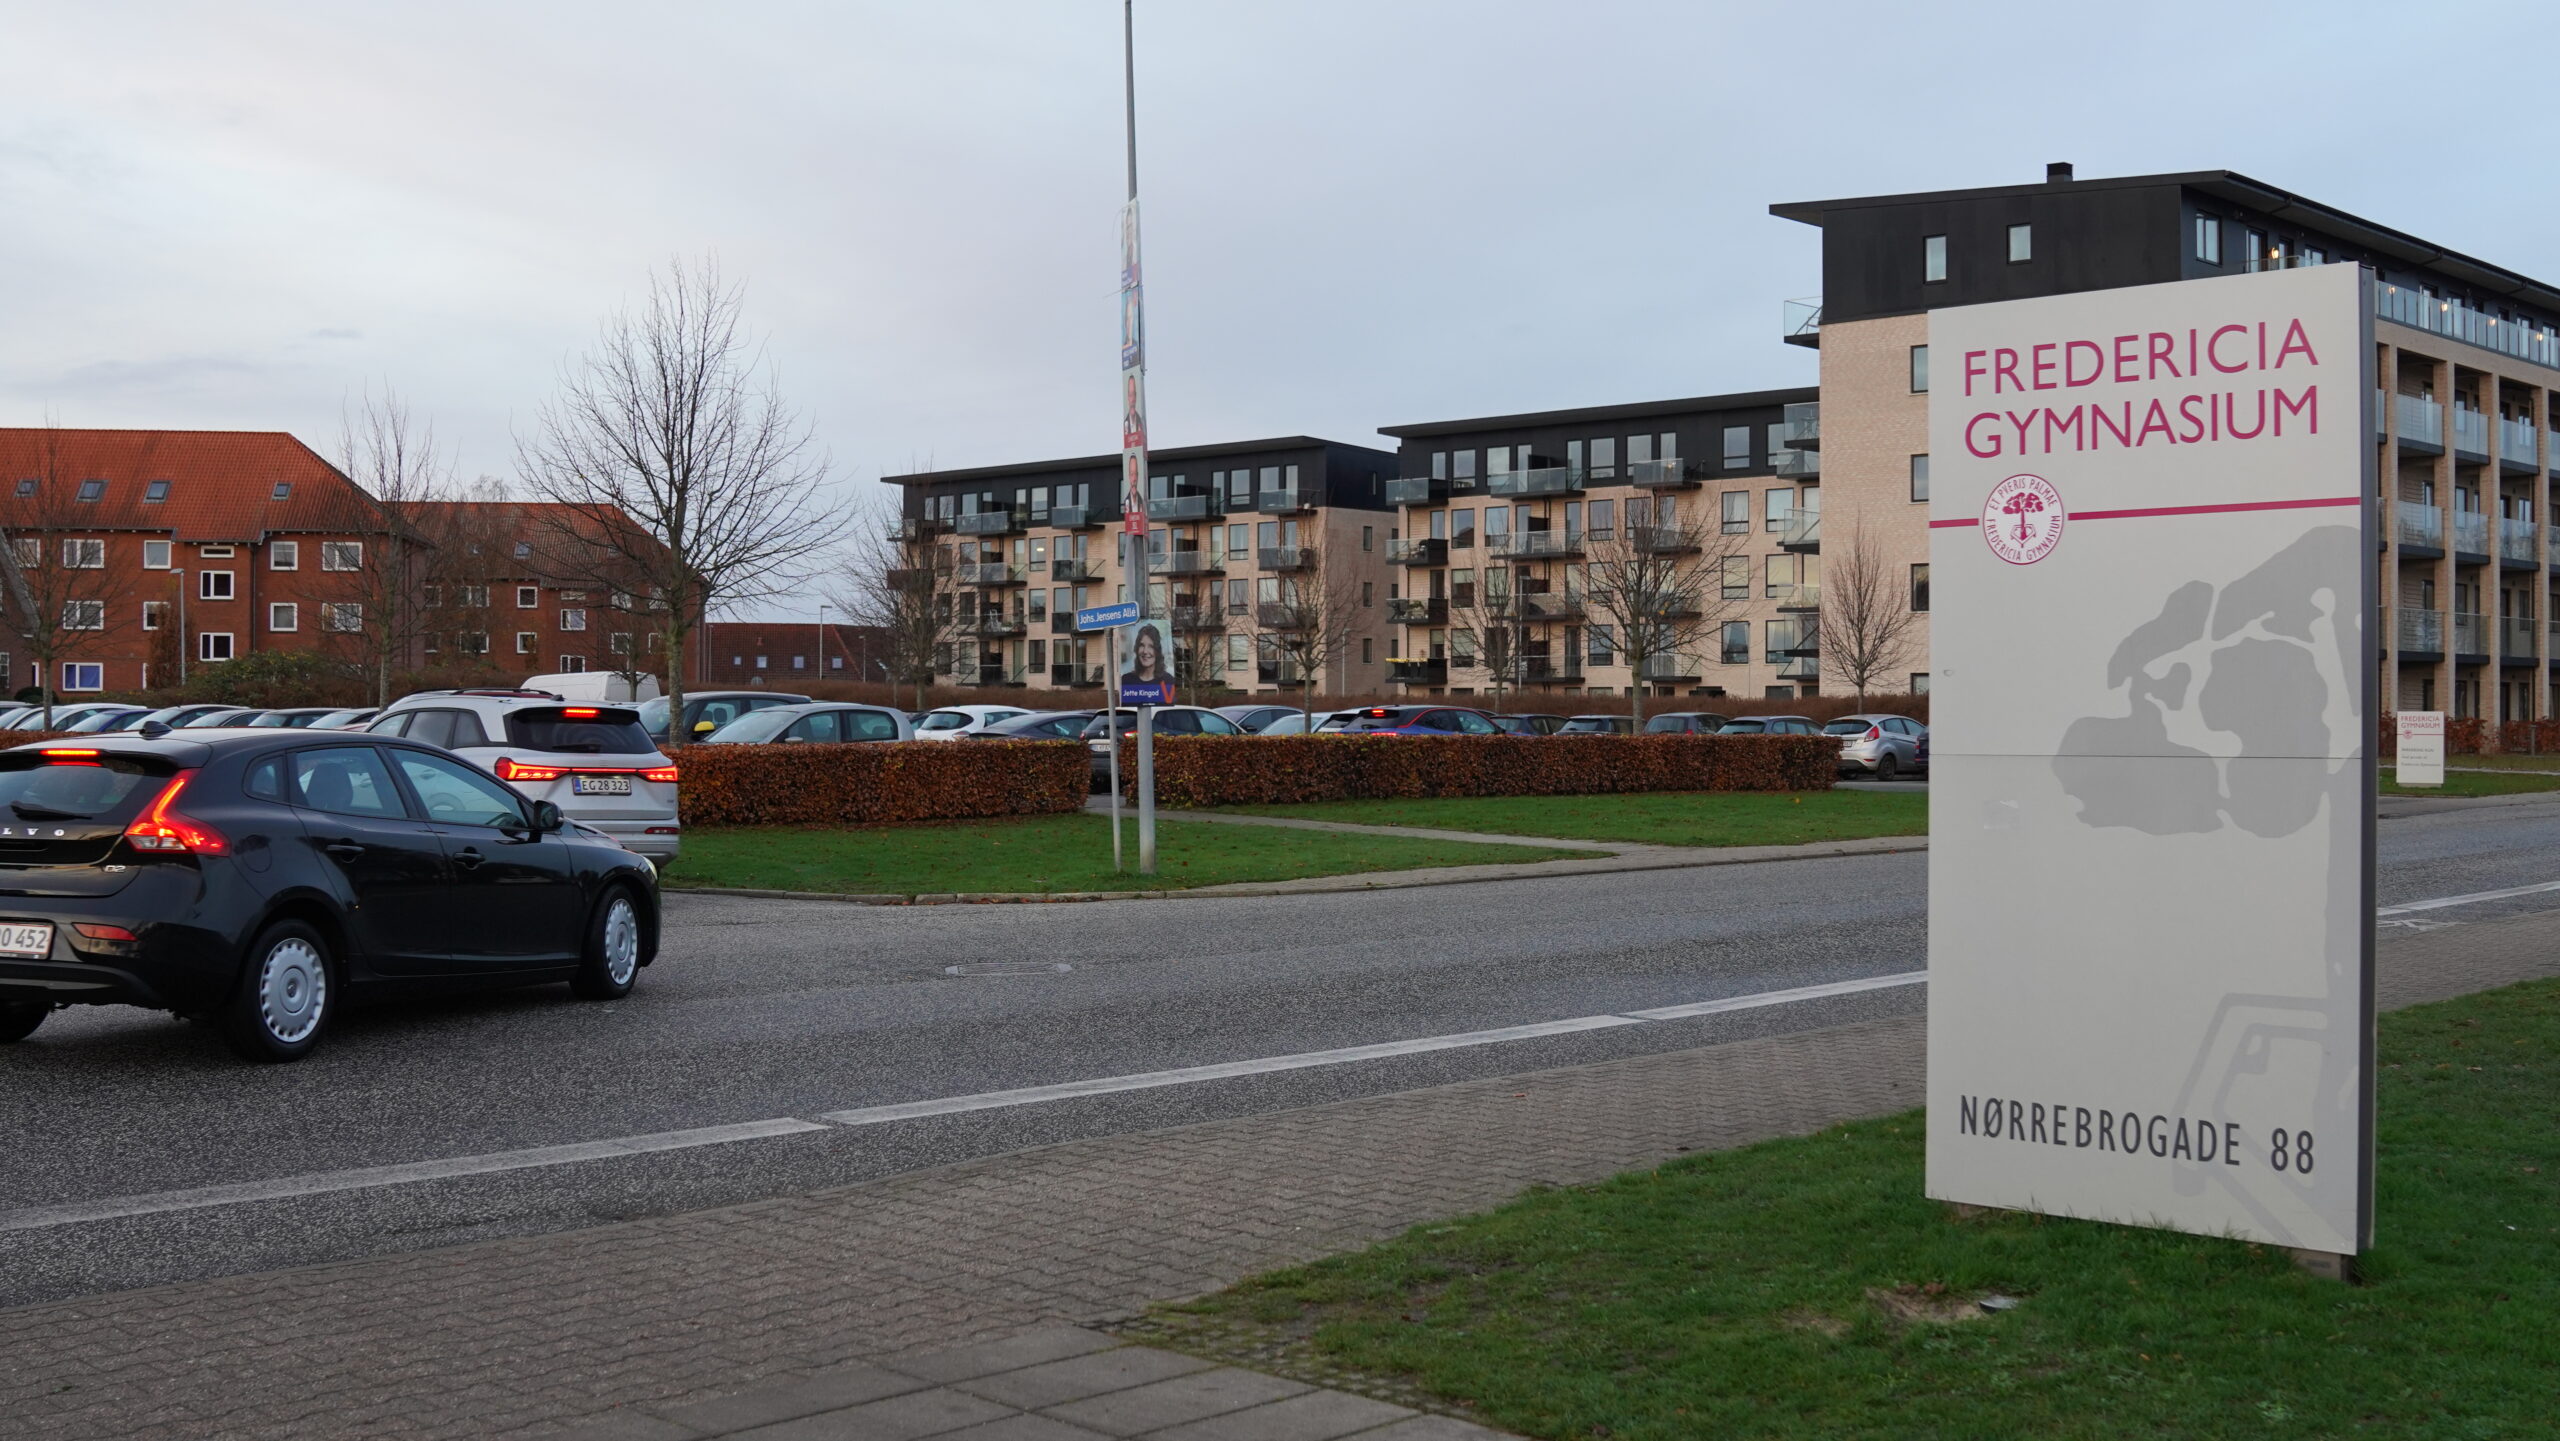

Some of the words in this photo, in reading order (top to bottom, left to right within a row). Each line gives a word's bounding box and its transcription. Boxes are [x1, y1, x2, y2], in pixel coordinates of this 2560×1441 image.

[1964, 318, 2319, 397] FREDERICIA
[1964, 385, 2318, 459] GYMNASIUM
[1986, 519, 2021, 561] FREDERICIA
[2026, 515, 2061, 560] GYMNASIUM
[1097, 611, 1122, 621] Jensens
[1122, 607, 1136, 618] Allé
[1139, 689, 1159, 698] Kingod
[582, 780, 596, 791] EG
[598, 780, 609, 791] 28
[611, 780, 629, 791] 323
[105, 865, 126, 873] D2
[0, 927, 12, 947] 0
[15, 928, 47, 949] 452
[1960, 1095, 2241, 1167] NØRREBROGADE
[2270, 1127, 2315, 1175] 88
